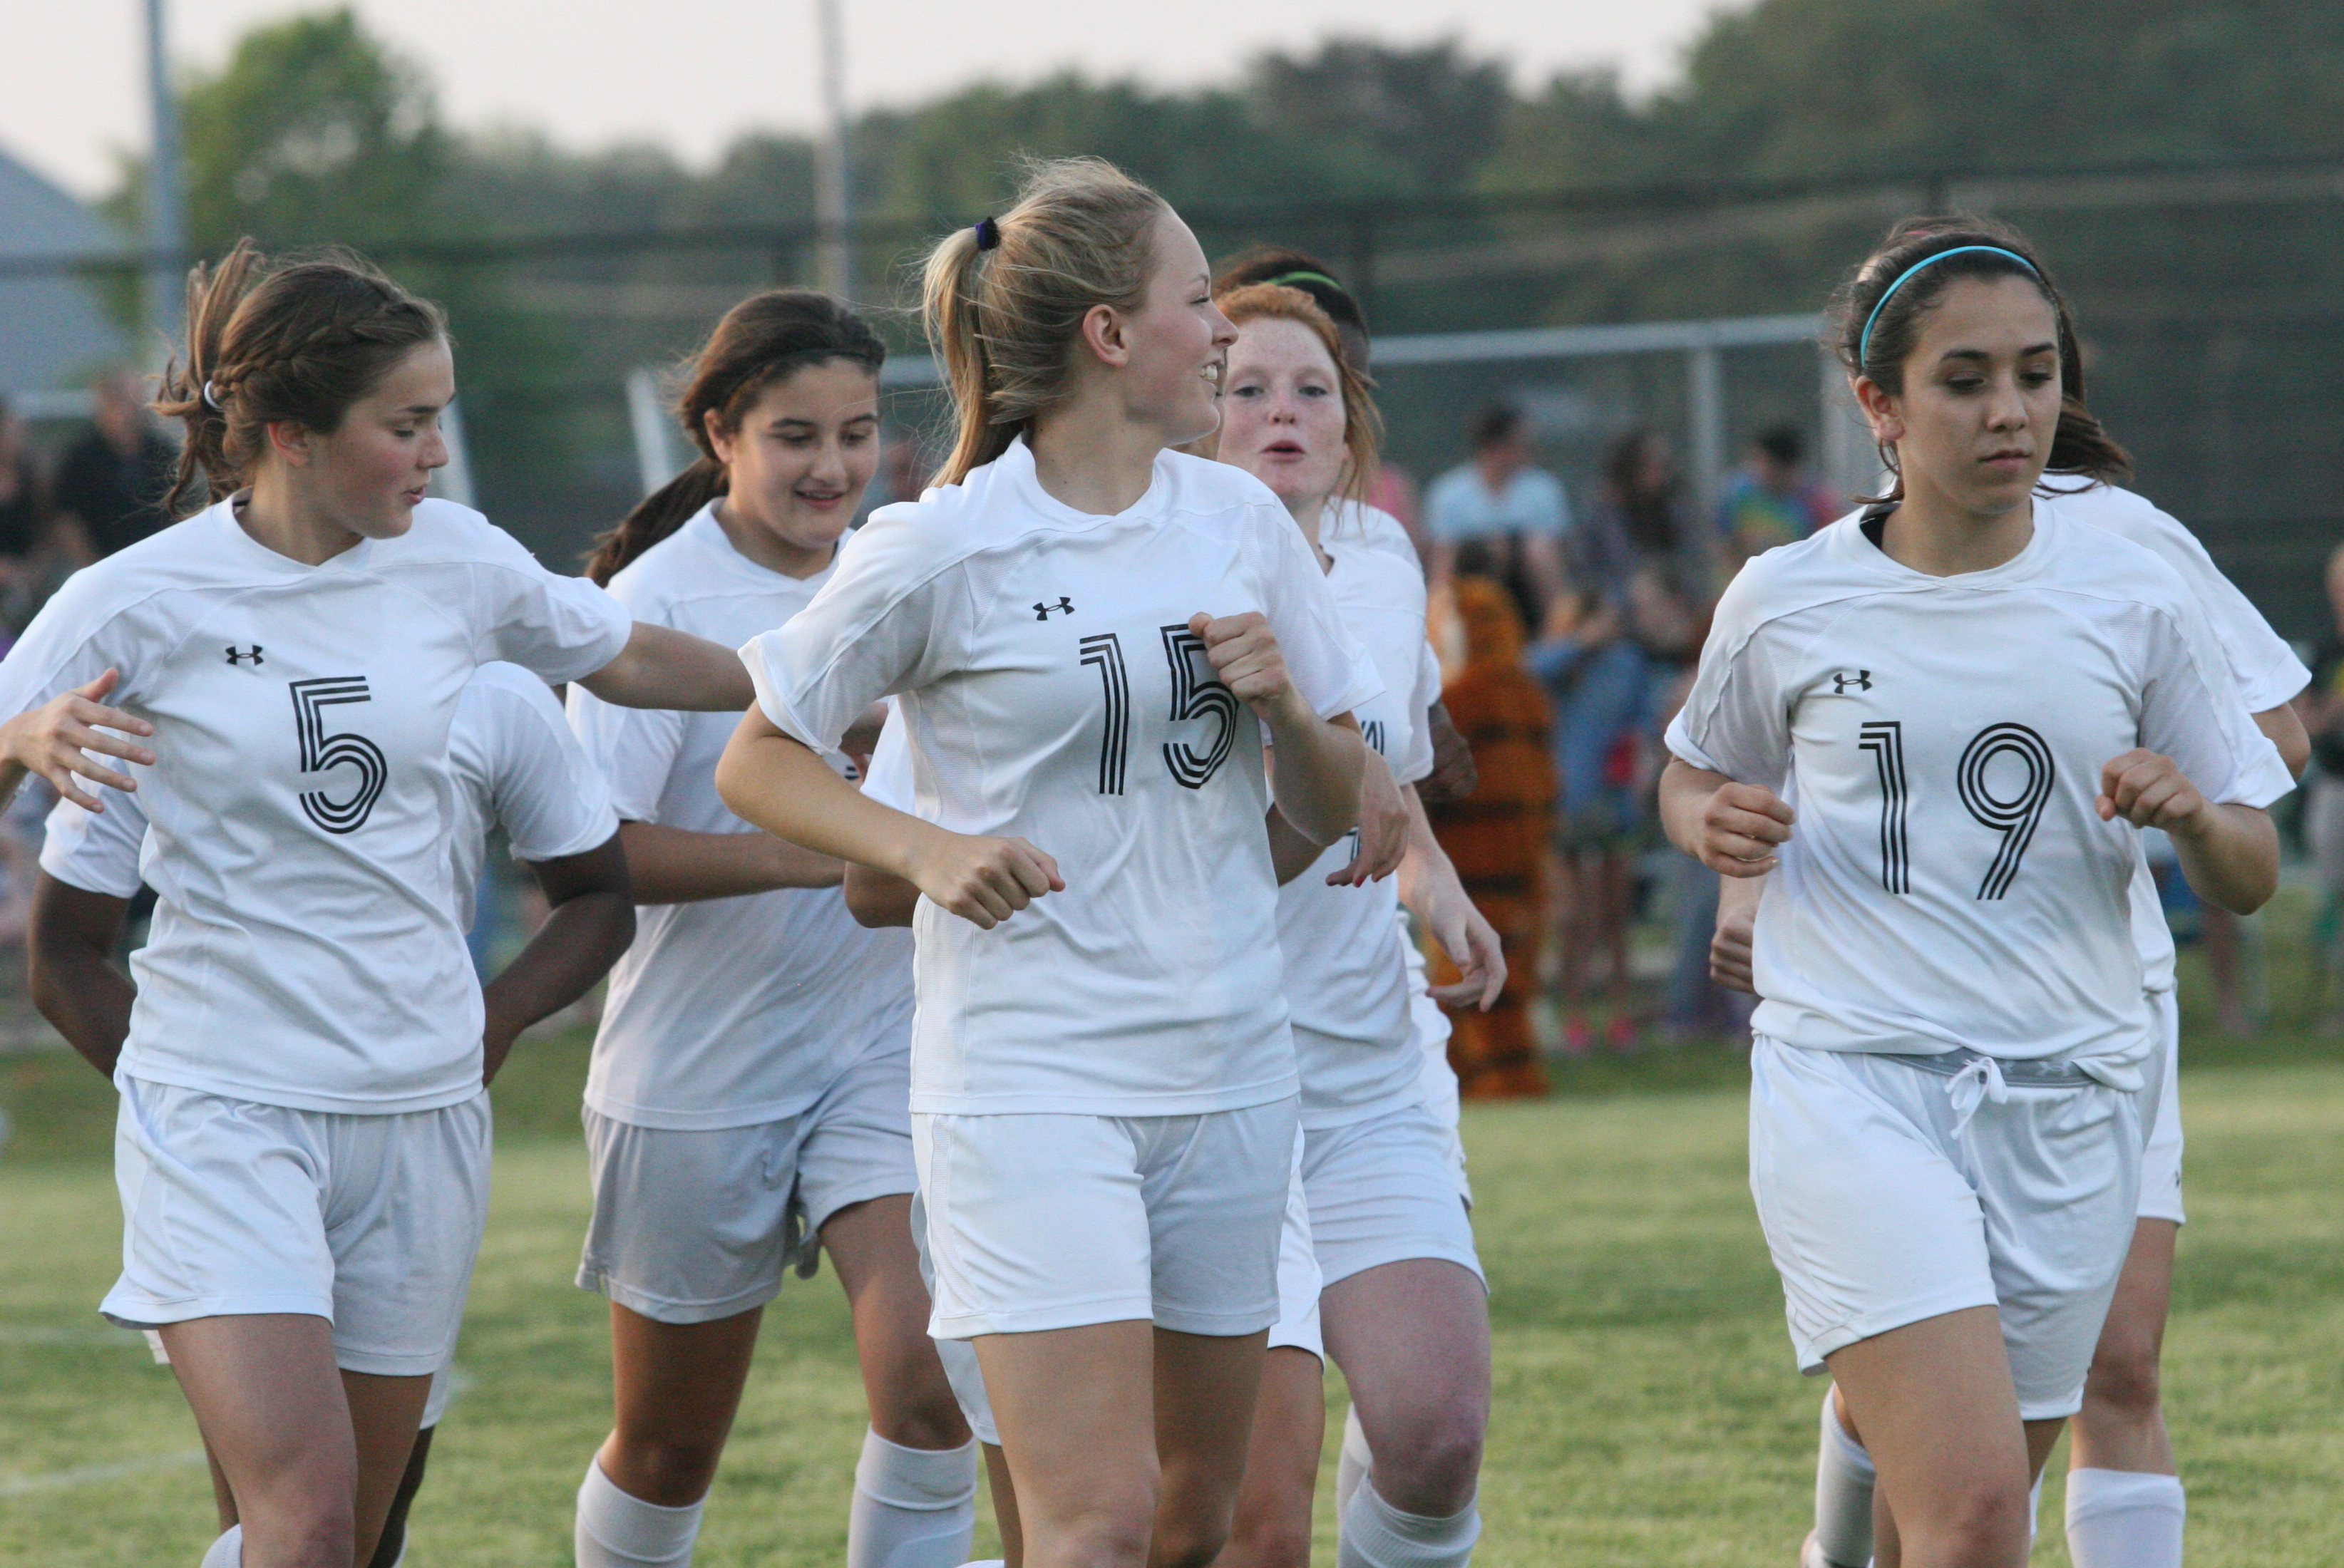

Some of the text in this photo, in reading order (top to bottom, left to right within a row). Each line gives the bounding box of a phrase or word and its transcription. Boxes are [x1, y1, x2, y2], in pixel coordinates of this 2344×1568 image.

[289, 676, 387, 834] 5
[1079, 623, 1239, 795] 15
[1859, 721, 2055, 900] 19
